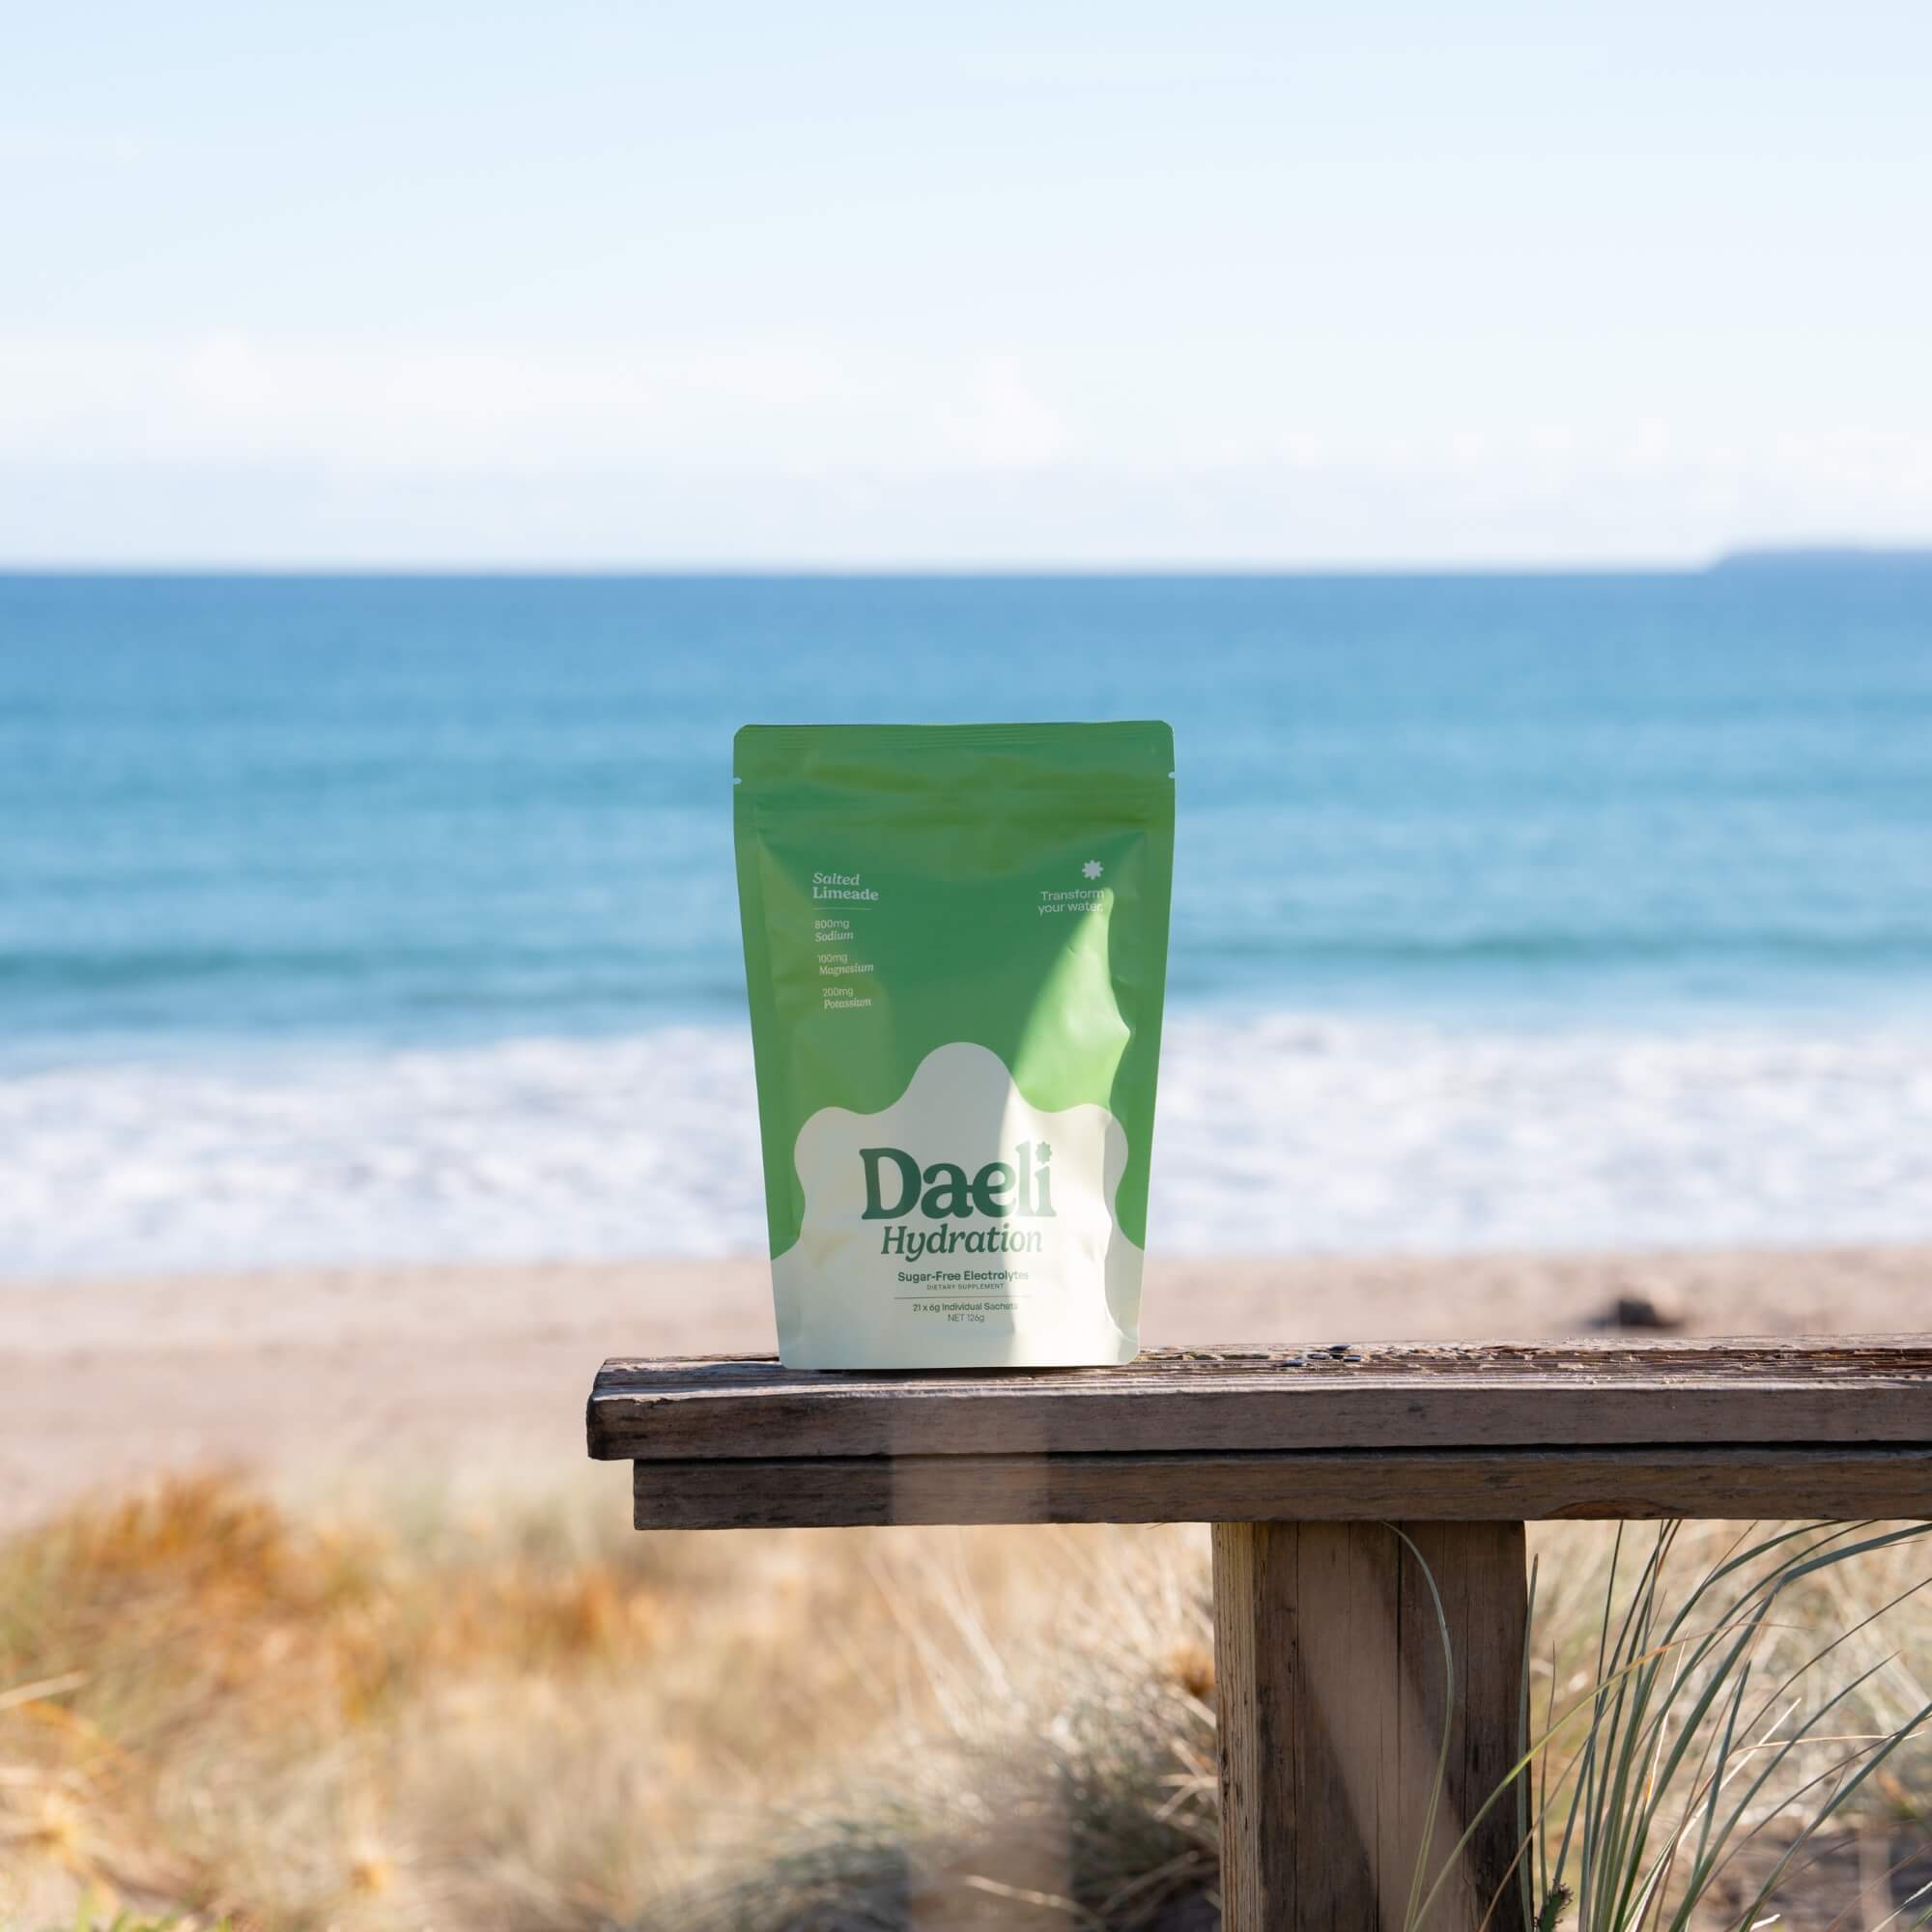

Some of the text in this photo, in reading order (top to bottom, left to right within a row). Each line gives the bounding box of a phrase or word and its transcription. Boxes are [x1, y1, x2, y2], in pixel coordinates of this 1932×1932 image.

[812, 871, 860, 886] Salted
[812, 886, 879, 900] Limeade
[1039, 889, 1104, 901] Transform
[1037, 903, 1065, 917] your
[815, 930, 854, 942] Sodium
[817, 953, 848, 964] 100mg
[819, 963, 874, 977] Magnesium
[822, 987, 853, 997] 200mg
[824, 998, 871, 1009] Potassium
[859, 1140, 1057, 1220] Daeli
[881, 1223, 1042, 1263] Hydration
[897, 1271, 961, 1283] Sugar-Free
[942, 1302, 982, 1311] Individual
[967, 1314, 985, 1322] 126g
